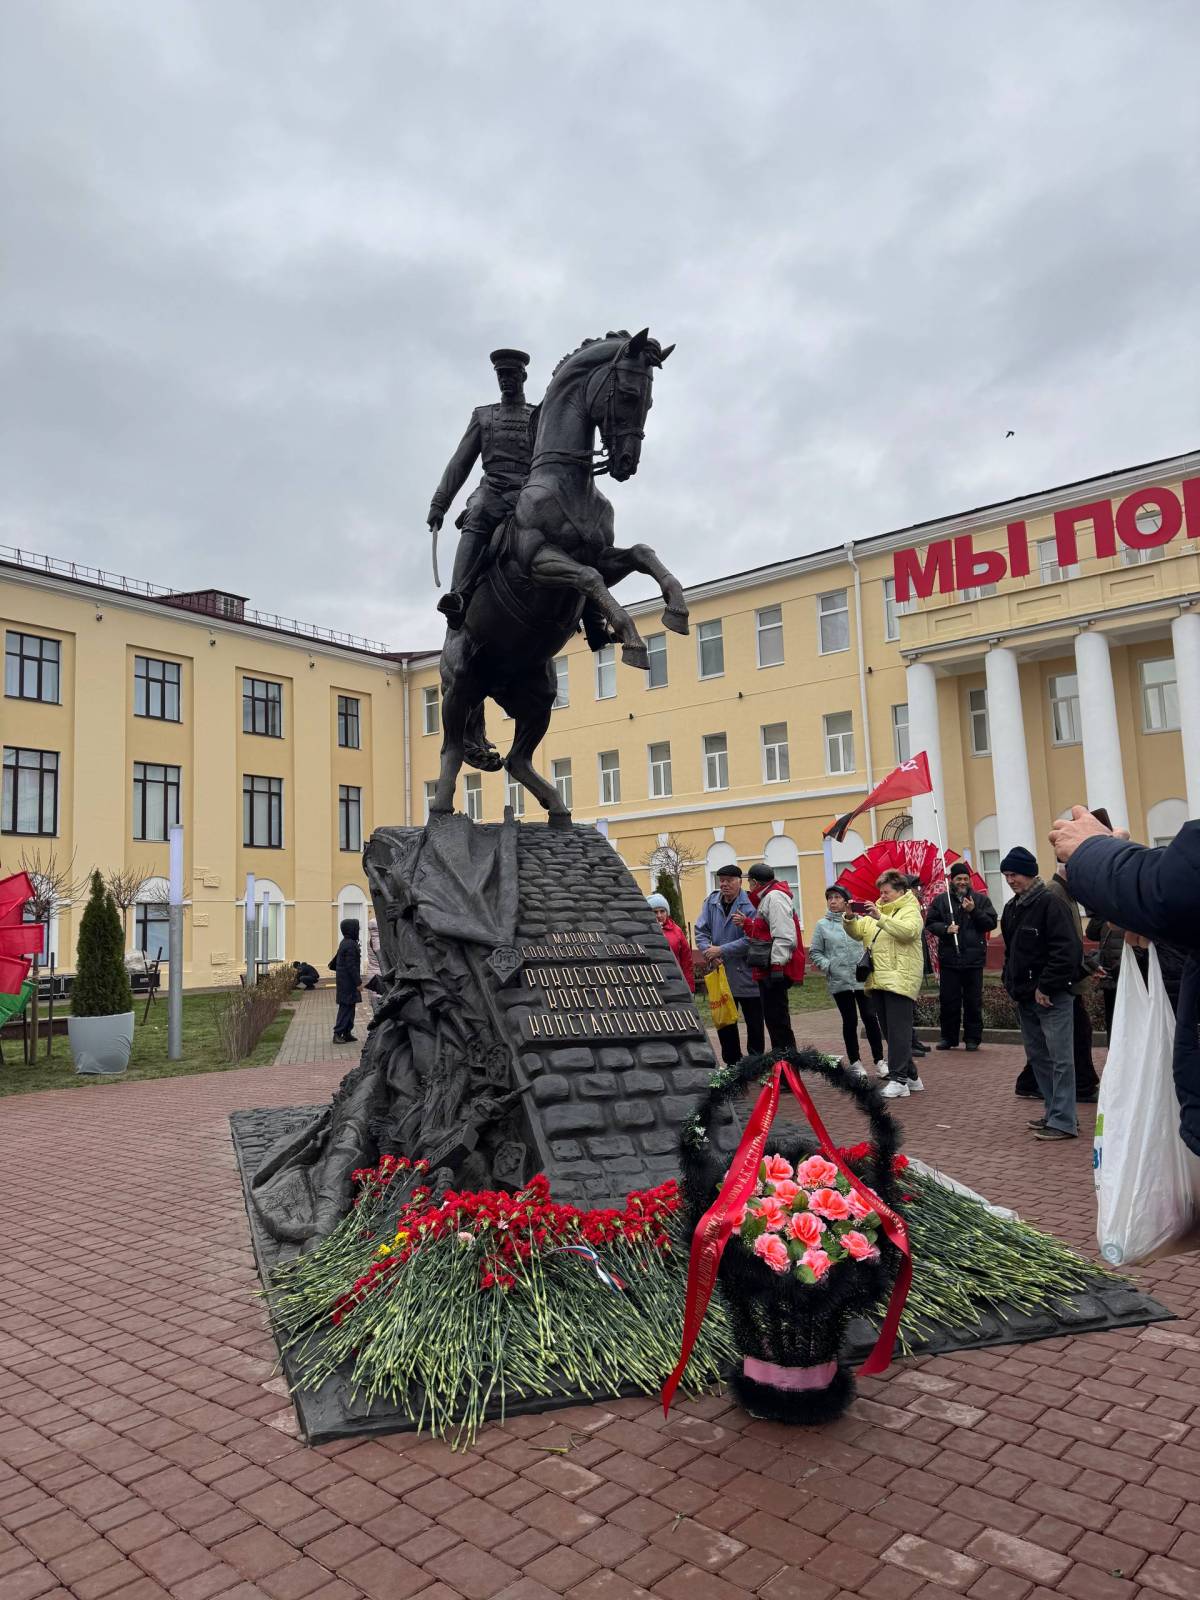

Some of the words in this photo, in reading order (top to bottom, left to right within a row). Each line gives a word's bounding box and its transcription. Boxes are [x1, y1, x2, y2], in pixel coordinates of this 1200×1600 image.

[894, 520, 1029, 603] МЫ
[1054, 477, 1200, 567] ПО
[552, 932, 603, 944] МАРШАЛ
[521, 946, 598, 958] СОВЕТСКОГО
[605, 943, 646, 956] СОЮЗА
[525, 964, 665, 986] РОКОССОВСКИЙ
[546, 986, 663, 1009] КОНСТАНТИН
[528, 1010, 699, 1037] КОНСТАНТИНОВИЧ
